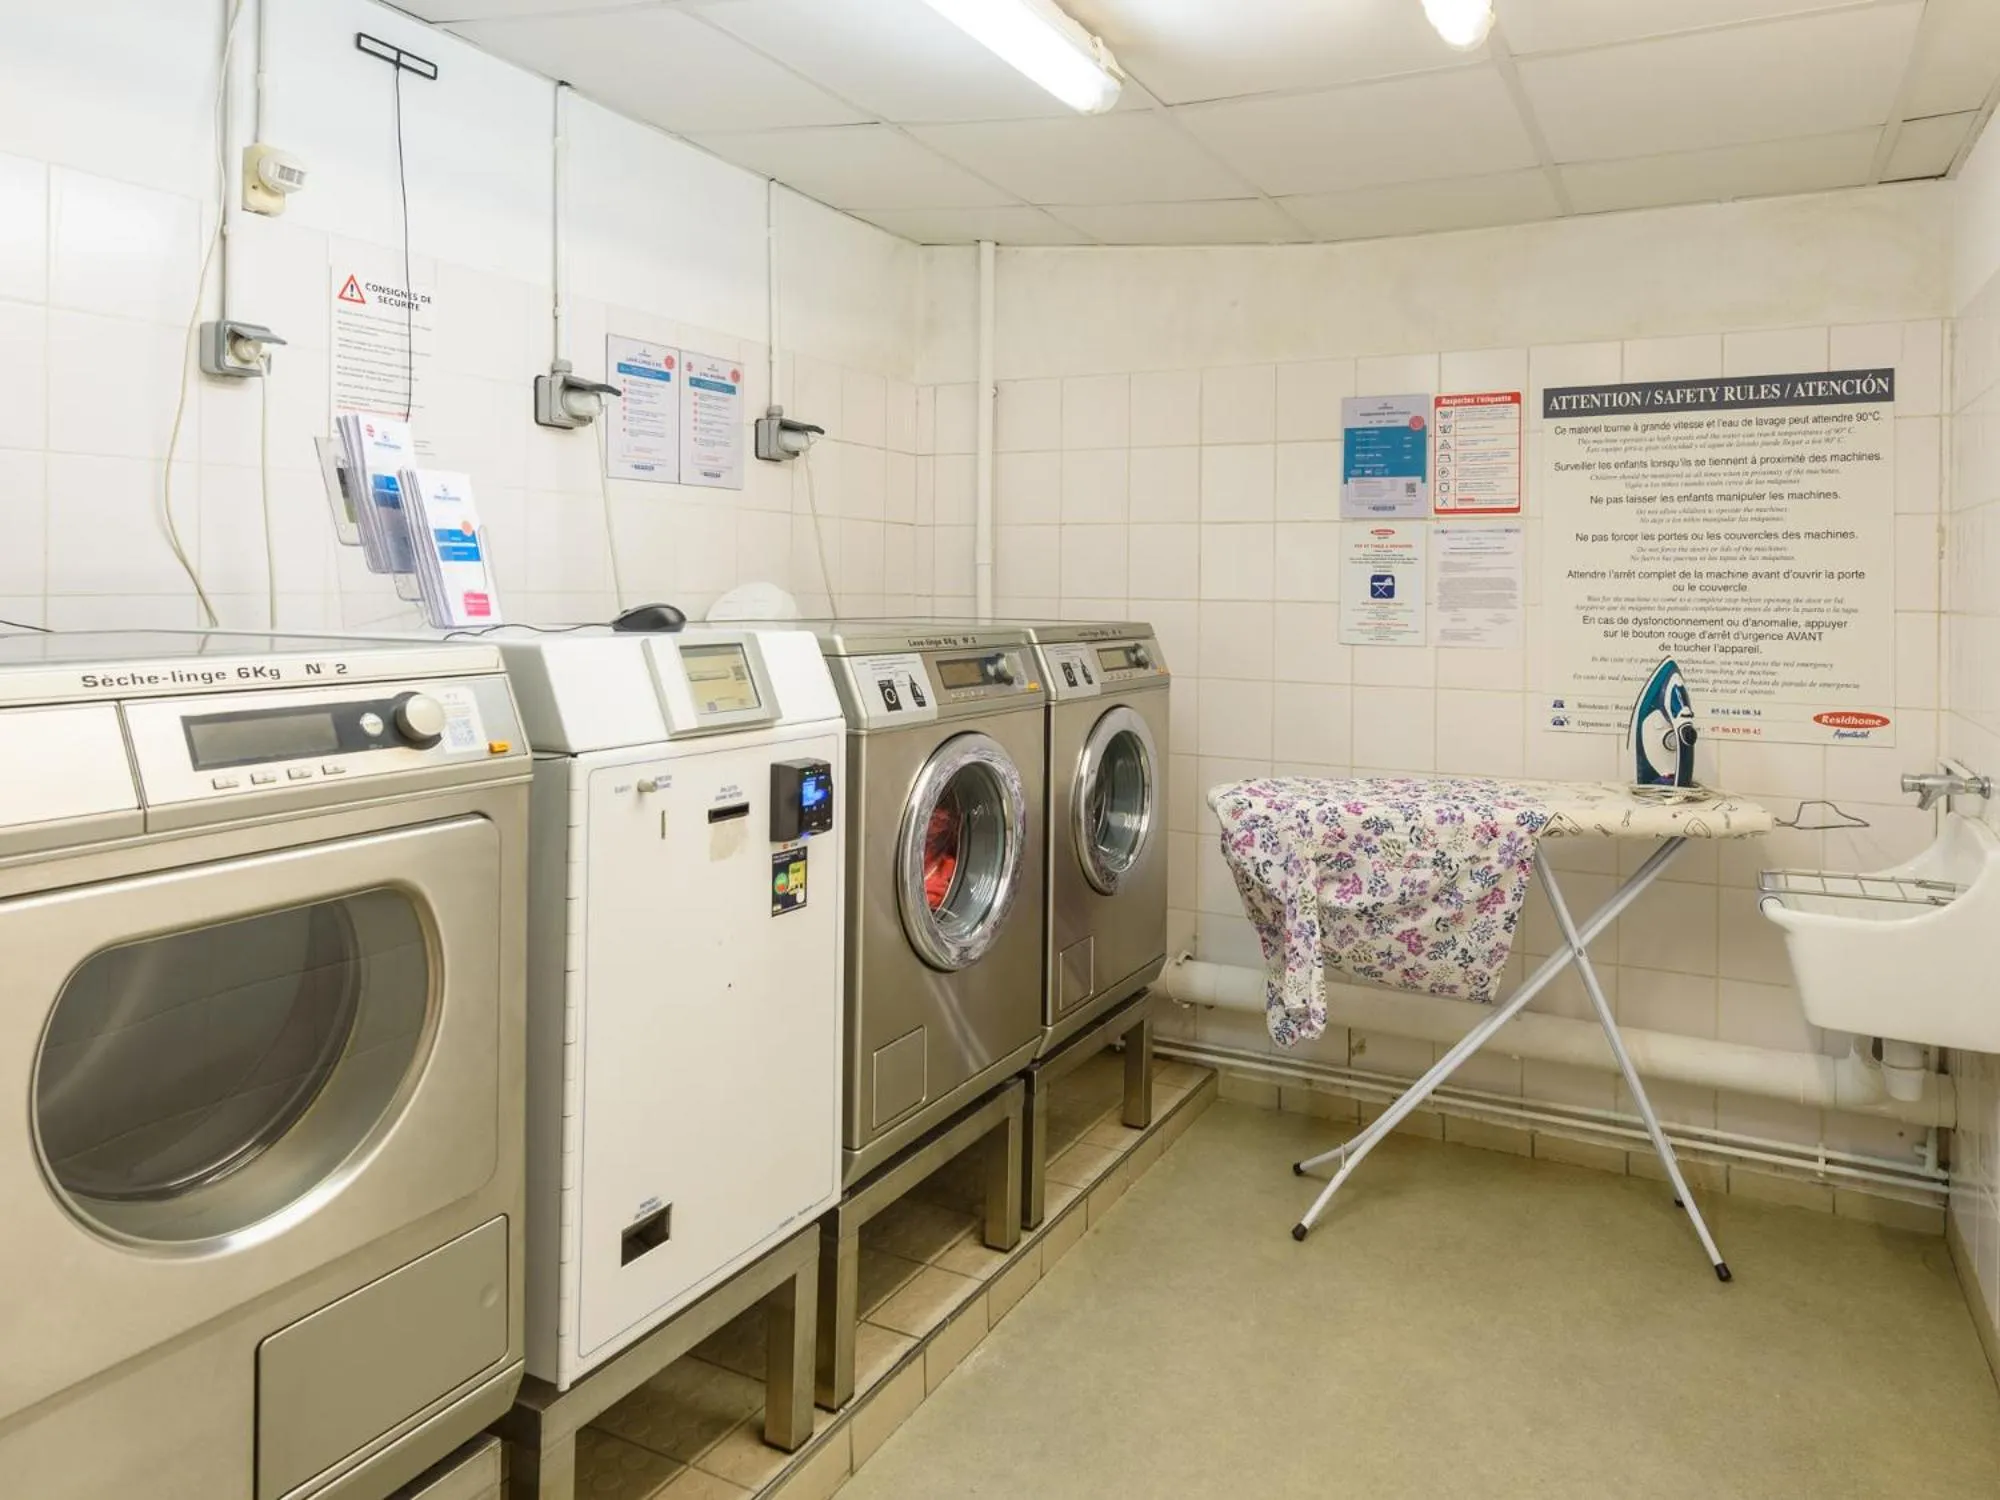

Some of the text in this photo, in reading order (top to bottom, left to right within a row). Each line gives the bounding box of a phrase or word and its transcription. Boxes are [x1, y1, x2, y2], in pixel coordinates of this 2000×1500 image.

[420, 296, 432, 304] DE
[1549, 373, 1889, 411] ATTENTION / SAFETY RULES / ATENCIÓN
[1554, 425, 1567, 435] Ce
[1604, 423, 1631, 433] tourne
[1633, 422, 1639, 432] à
[1641, 421, 1672, 435] grande
[1673, 419, 1704, 430] vitesse
[1706, 419, 1716, 428] et
[1741, 415, 1753, 426] de
[1755, 414, 1786, 427] lavage
[1788, 413, 1809, 426] peut
[1811, 412, 1853, 424] atteindre
[1598, 461, 1612, 471] les
[1614, 460, 1648, 470] enfants
[1694, 459, 1706, 467] se
[1708, 455, 1748, 466] tiennent
[1750, 455, 1757, 465] à
[1759, 454, 1806, 466] proximité
[1808, 452, 1827, 463] des
[1830, 451, 1884, 462] machines.
[1590, 489, 1841, 506] Ne pas laisser les enfants manipuler les machines.
[1575, 528, 1858, 543] Ne pas forcer les portes ou les couvercles des machines.
[1567, 568, 1865, 582] Attendre l'arrêt complet de la machine avant d'ouvrir la porte
[1672, 584, 1684, 592] ou
[1687, 582, 1696, 592] le
[1582, 615, 1848, 631] En cas de dysfonctionnement ou d'anomalie, appuyer
[1603, 628, 1823, 643] sur le bouton rouge d'arrêt d'urgence AVANT
[1658, 643, 1763, 655] de toucher l'appareil.
[81, 670, 227, 689] Sèche-linge
[237, 666, 281, 680] 6Kg
[335, 663, 348, 674] 2
[1821, 714, 1881, 726] Residhome
